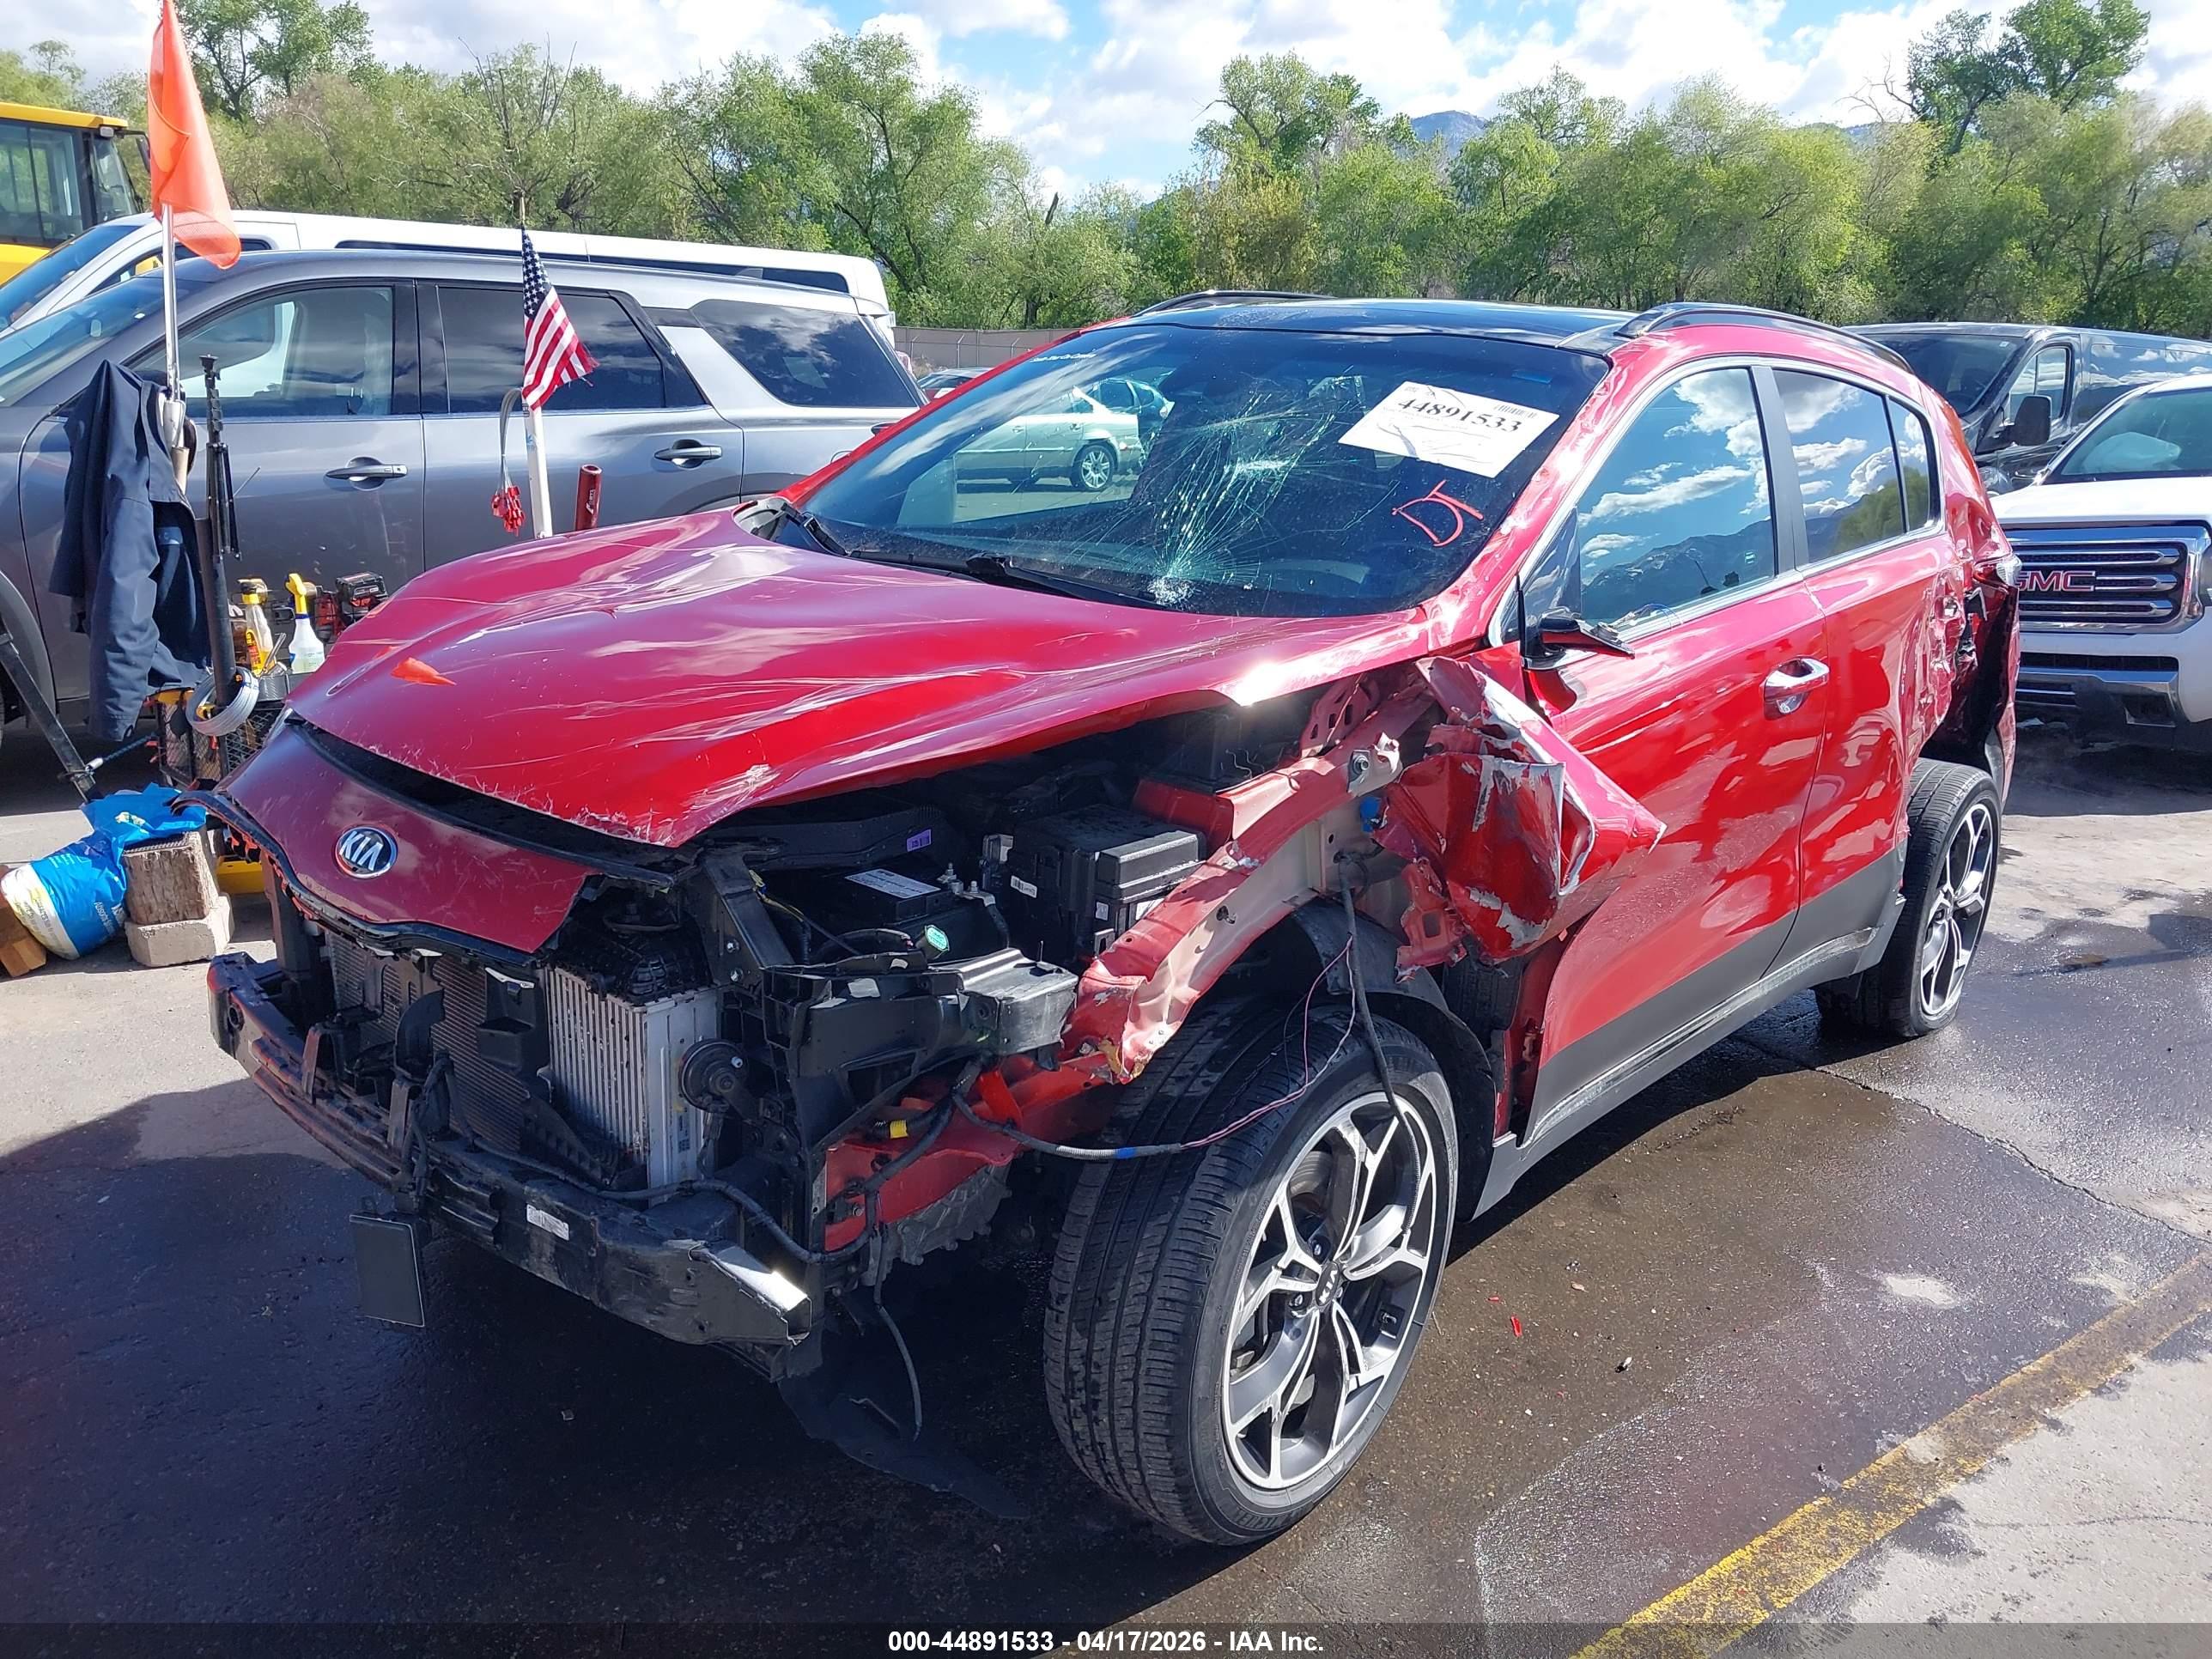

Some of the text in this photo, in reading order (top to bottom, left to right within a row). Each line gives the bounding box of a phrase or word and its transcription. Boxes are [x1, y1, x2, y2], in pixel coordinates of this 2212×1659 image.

[1397, 398, 1522, 433] 44891533
[338, 830, 384, 871] KIA
[1318, 1270, 1338, 1304] KIA
